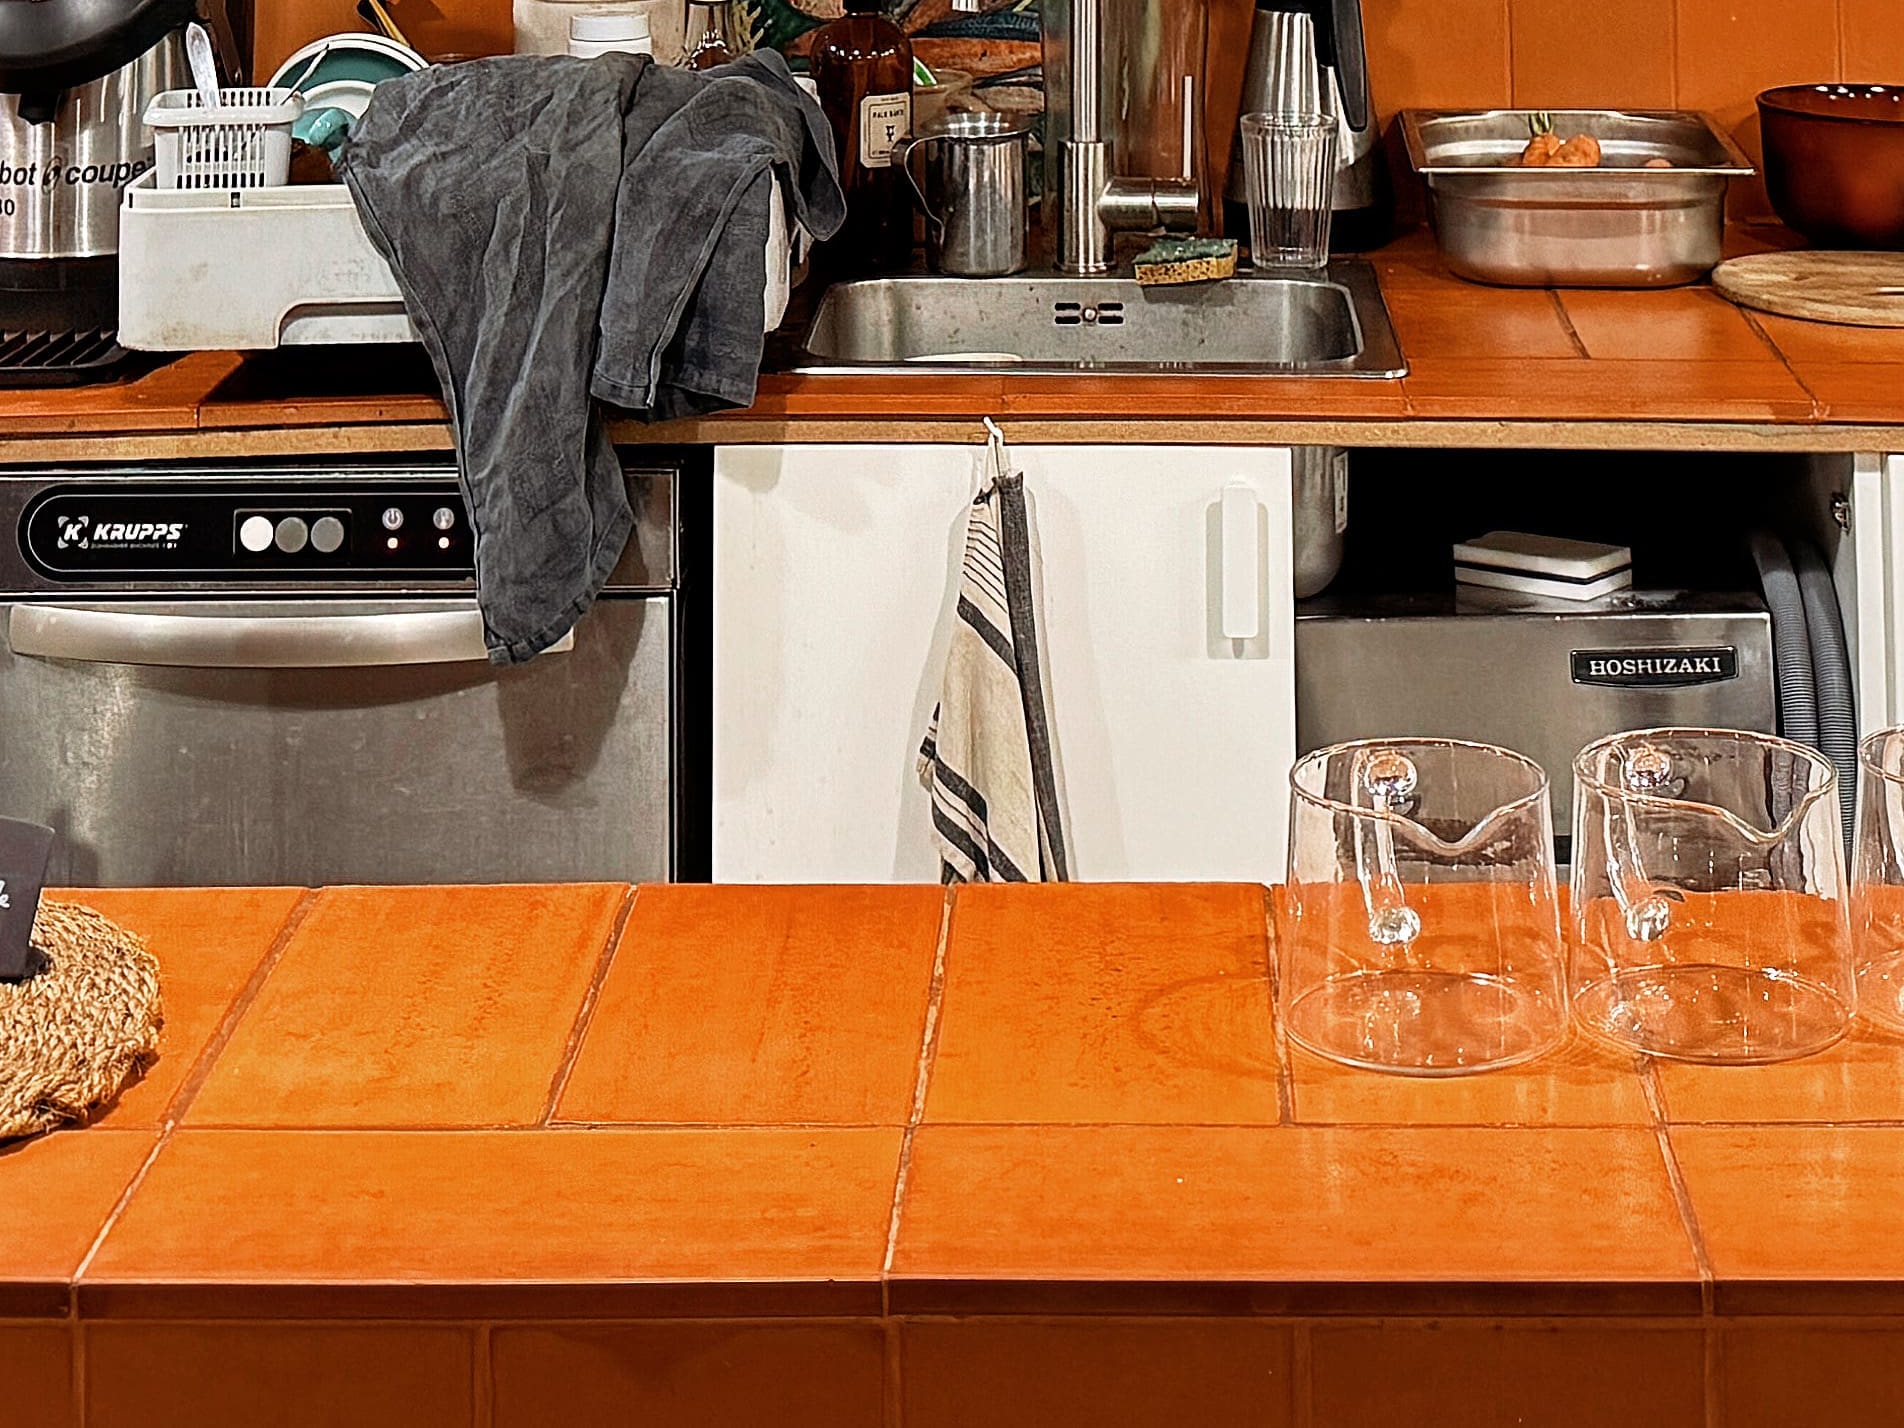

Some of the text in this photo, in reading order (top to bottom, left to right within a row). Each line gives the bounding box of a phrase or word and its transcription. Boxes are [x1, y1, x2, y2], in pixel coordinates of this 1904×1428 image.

[65, 160, 146, 188] coupe
[94, 524, 183, 540] KRUPPS
[1590, 657, 1721, 676] HOSHIZAKI
